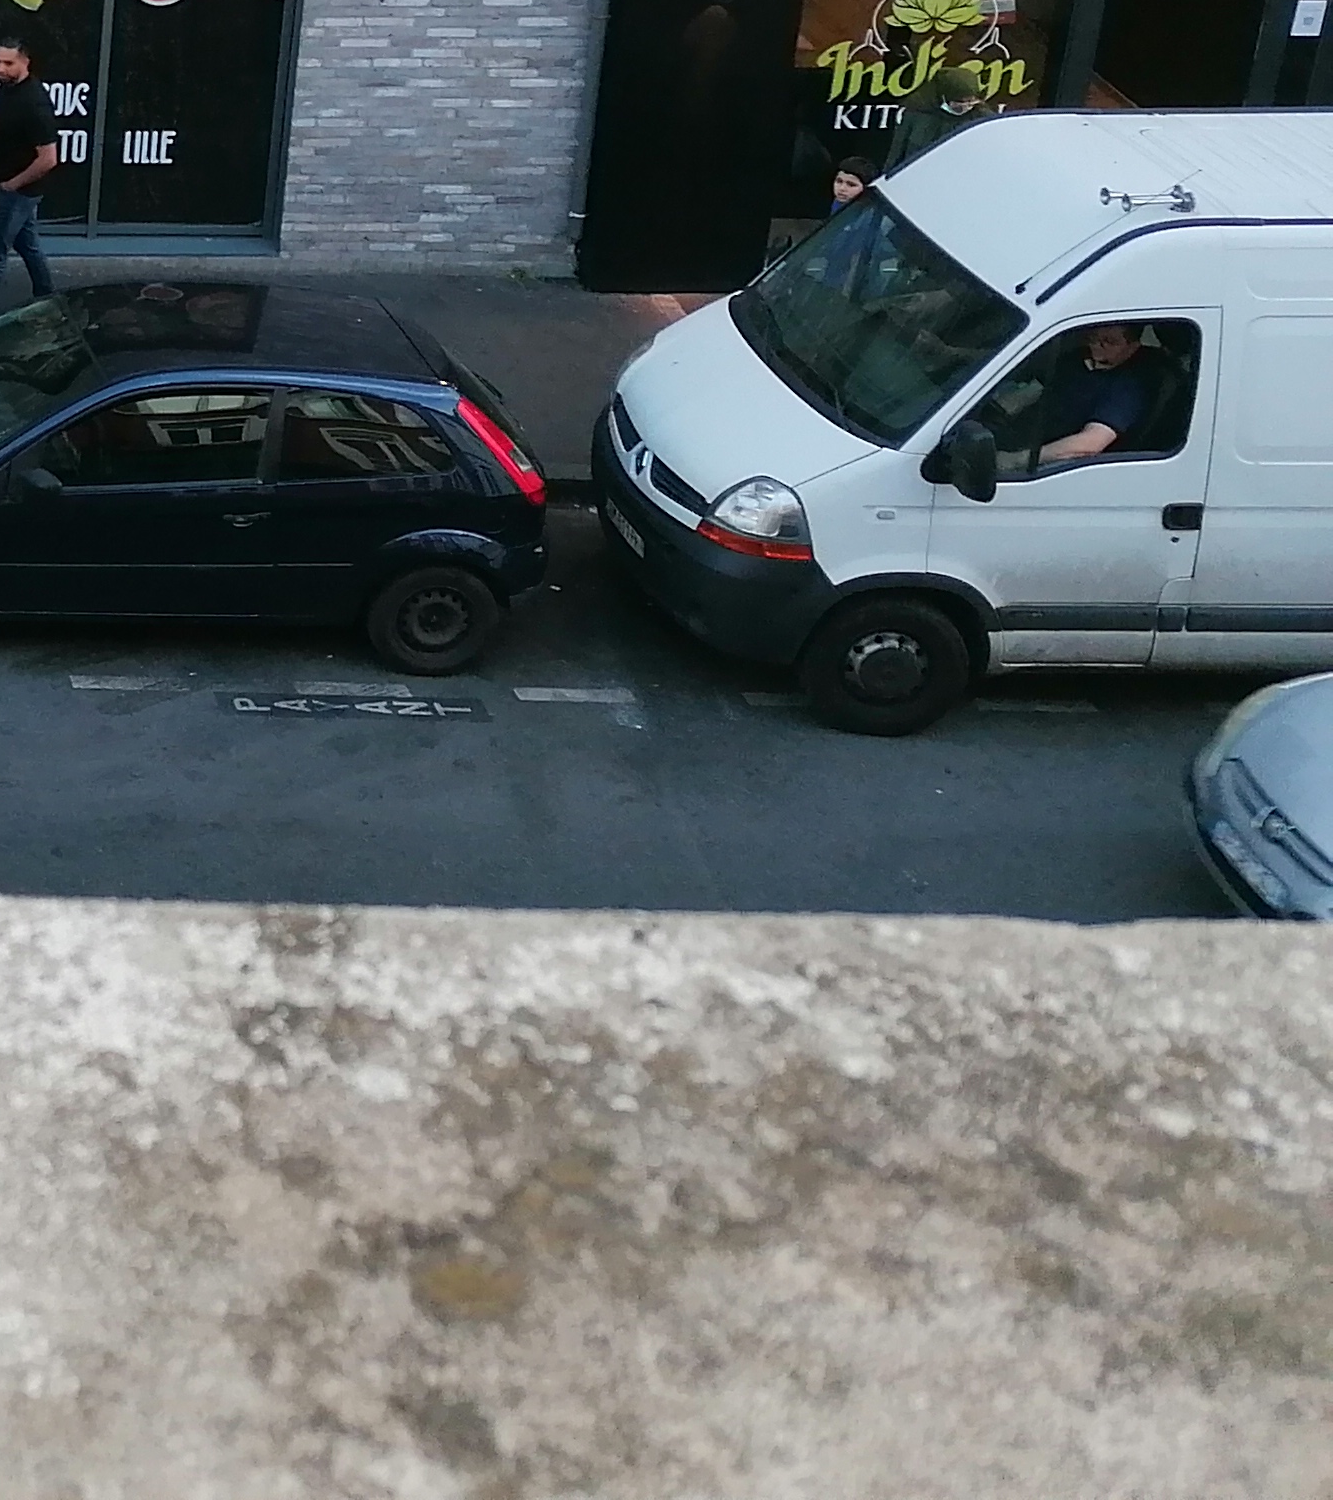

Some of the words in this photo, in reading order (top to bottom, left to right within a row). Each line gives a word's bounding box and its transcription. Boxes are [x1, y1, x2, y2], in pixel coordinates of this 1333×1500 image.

[57, 130, 87, 163] TO
[123, 130, 177, 164] LILLE
[233, 697, 472, 716] PAYANT
